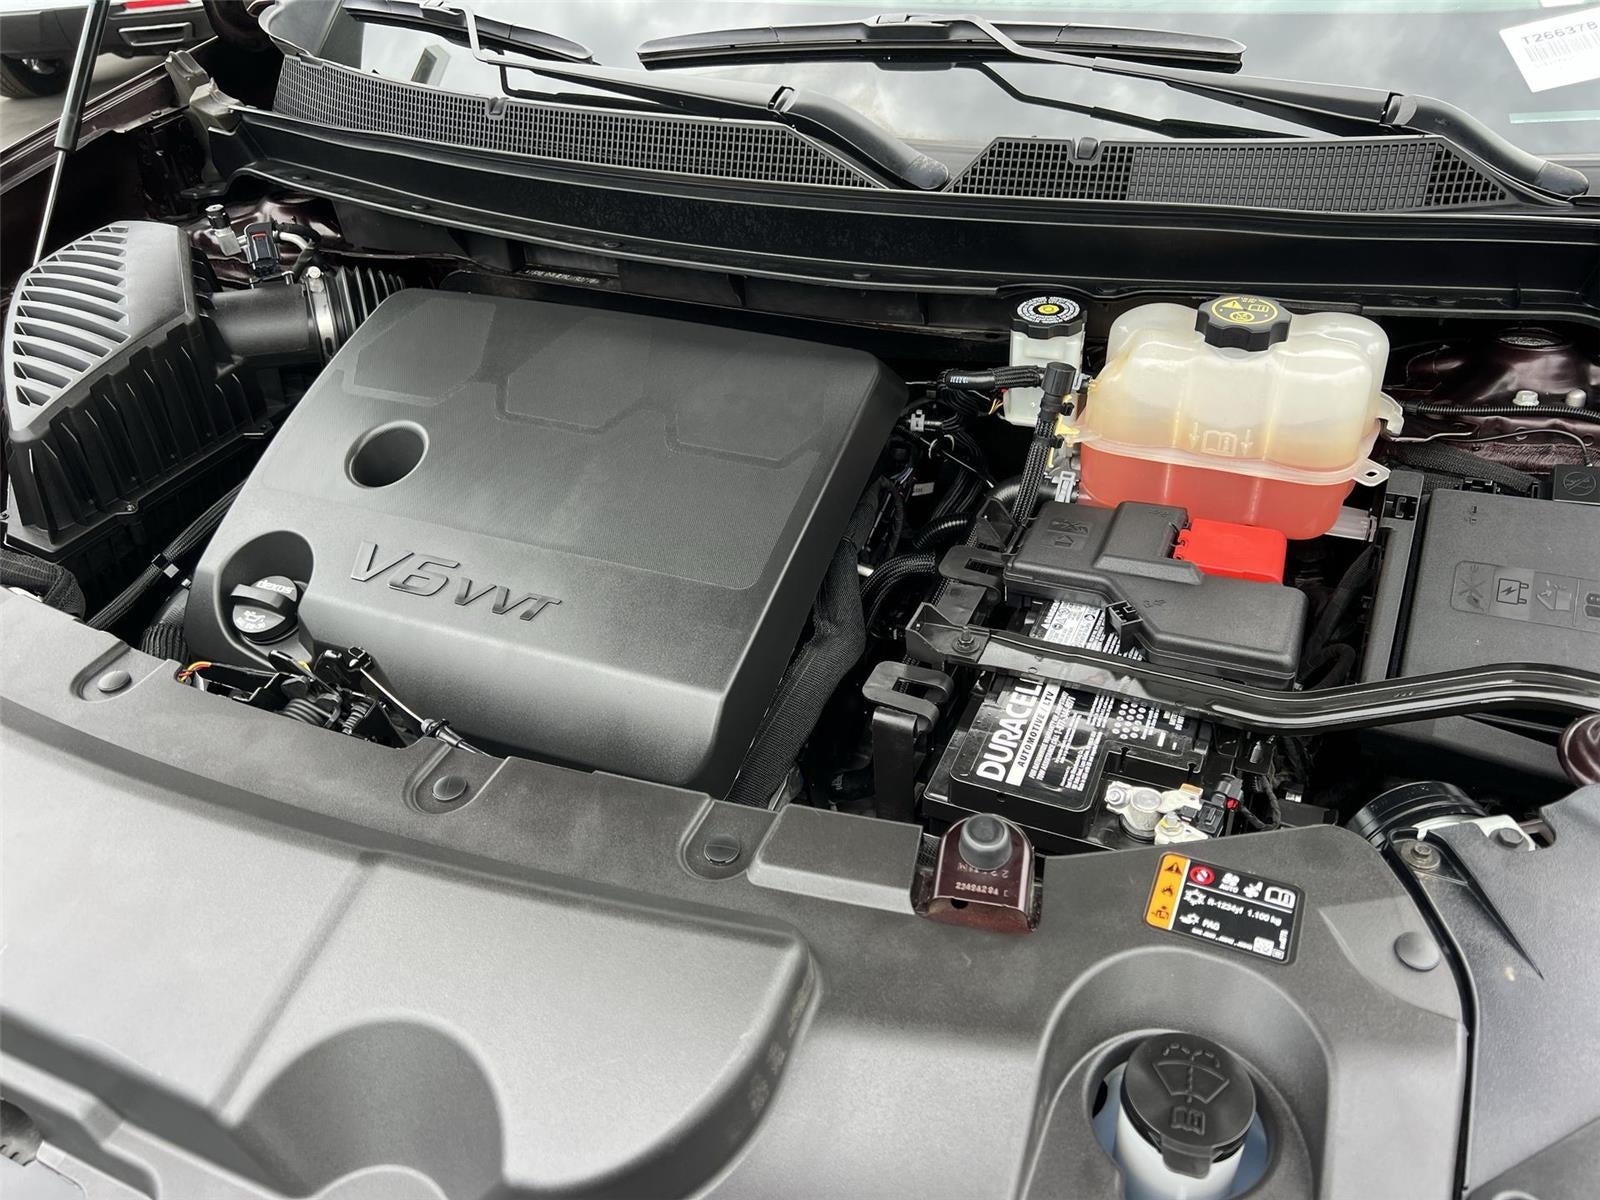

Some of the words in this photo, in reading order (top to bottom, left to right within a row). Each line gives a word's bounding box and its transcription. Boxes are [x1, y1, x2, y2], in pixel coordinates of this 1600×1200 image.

[1521, 21, 1599, 45] T26637B
[256, 579, 295, 594] dexos
[351, 541, 461, 597] V6
[455, 577, 562, 621] VVT
[1017, 714, 1045, 767] AUTOMOTIVE
[1043, 690, 1055, 707] LTV
[1218, 882, 1240, 894] AUTO
[1206, 898, 1244, 914] R-1234yf
[1270, 915, 1282, 928] kg
